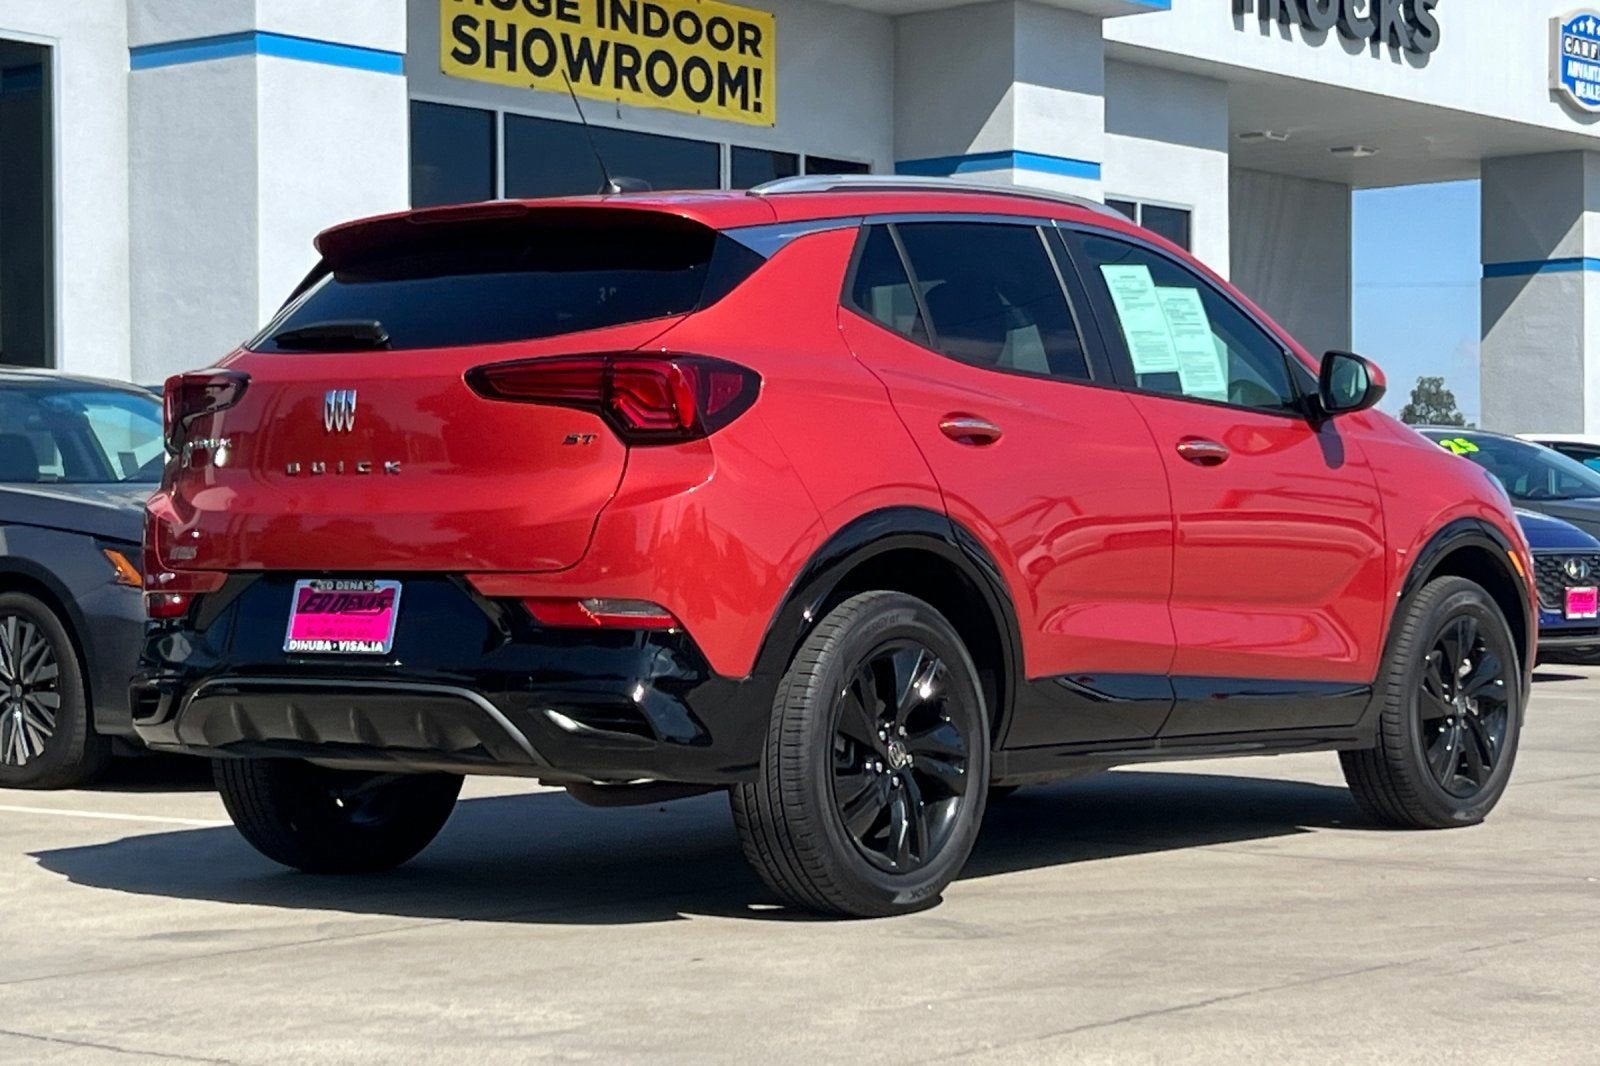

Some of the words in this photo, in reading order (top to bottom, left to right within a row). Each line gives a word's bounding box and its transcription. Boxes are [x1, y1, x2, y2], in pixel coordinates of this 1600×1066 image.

[453, 0, 581, 24] GE
[596, 0, 763, 59] INDOOR
[1232, 0, 1440, 54] UCKS
[450, 13, 763, 114] SHOWROOM!
[562, 432, 602, 446] ST
[286, 460, 401, 475] BUICK
